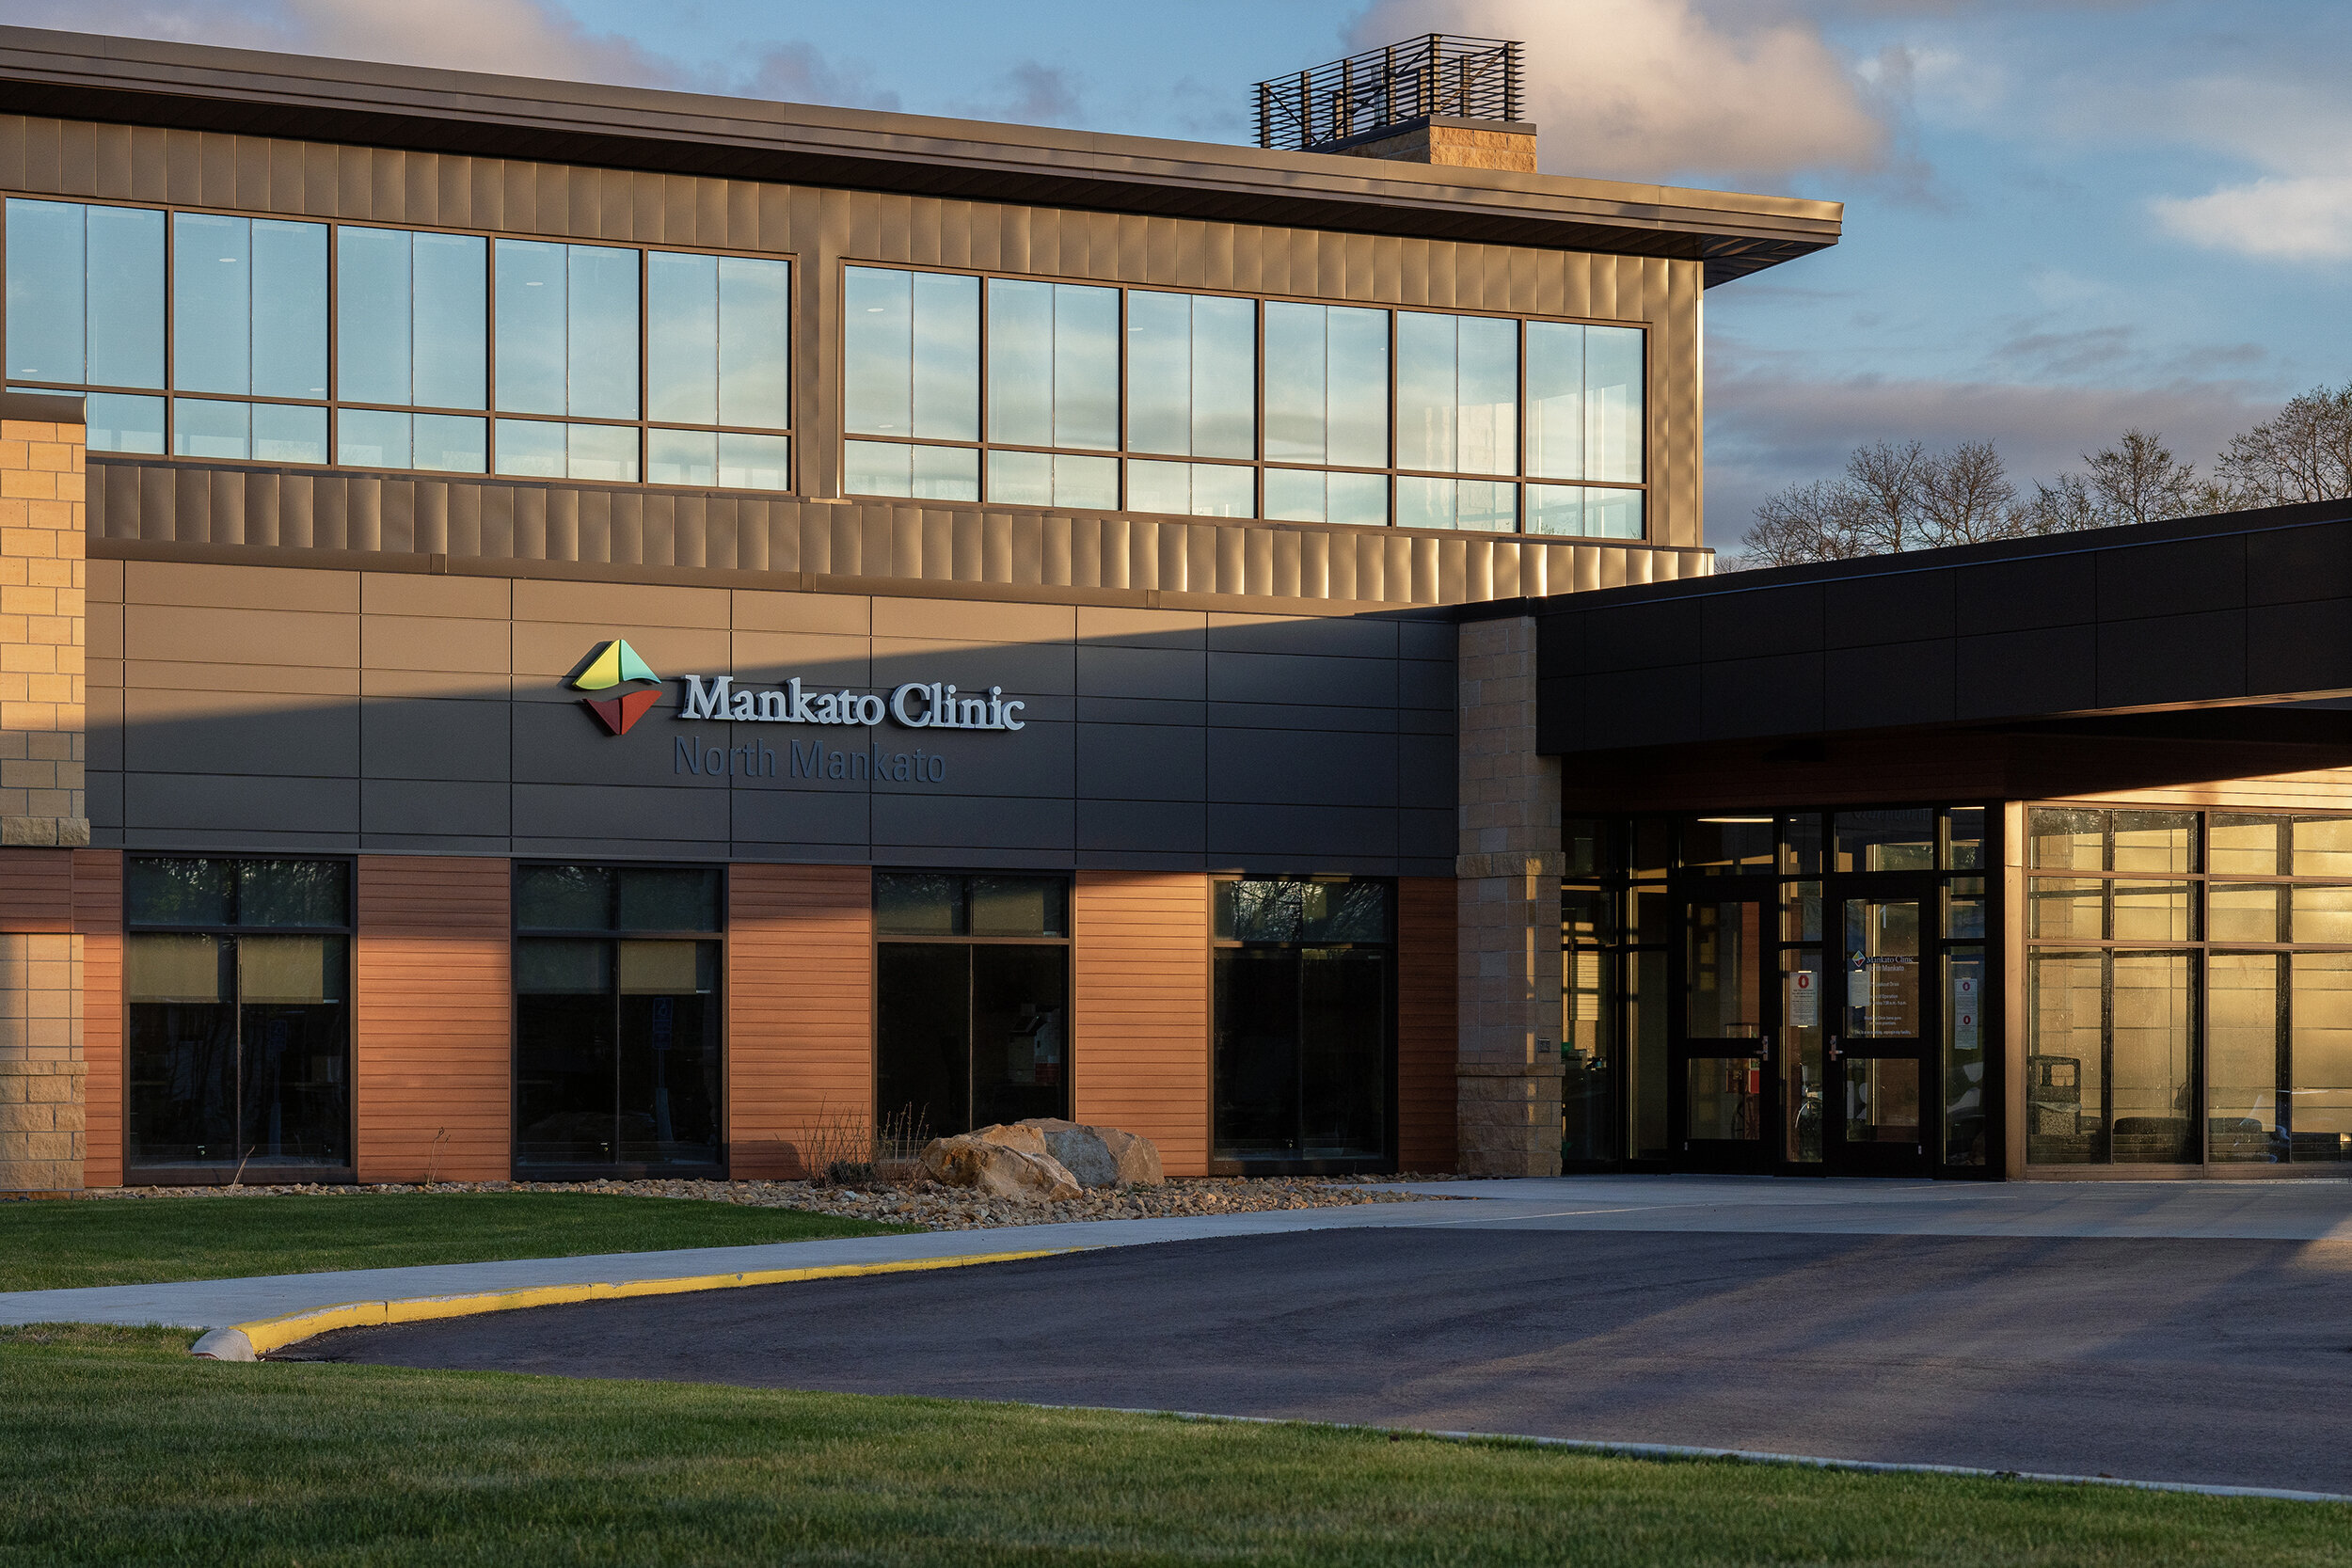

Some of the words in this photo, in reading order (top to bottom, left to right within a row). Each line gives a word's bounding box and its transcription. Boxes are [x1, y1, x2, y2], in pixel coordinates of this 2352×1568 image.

[678, 674, 886, 726] Mankato
[889, 682, 1025, 731] Clinic
[675, 736, 776, 777] North
[790, 738, 946, 783] Mankato
[1879, 905, 1886, 928] 1
